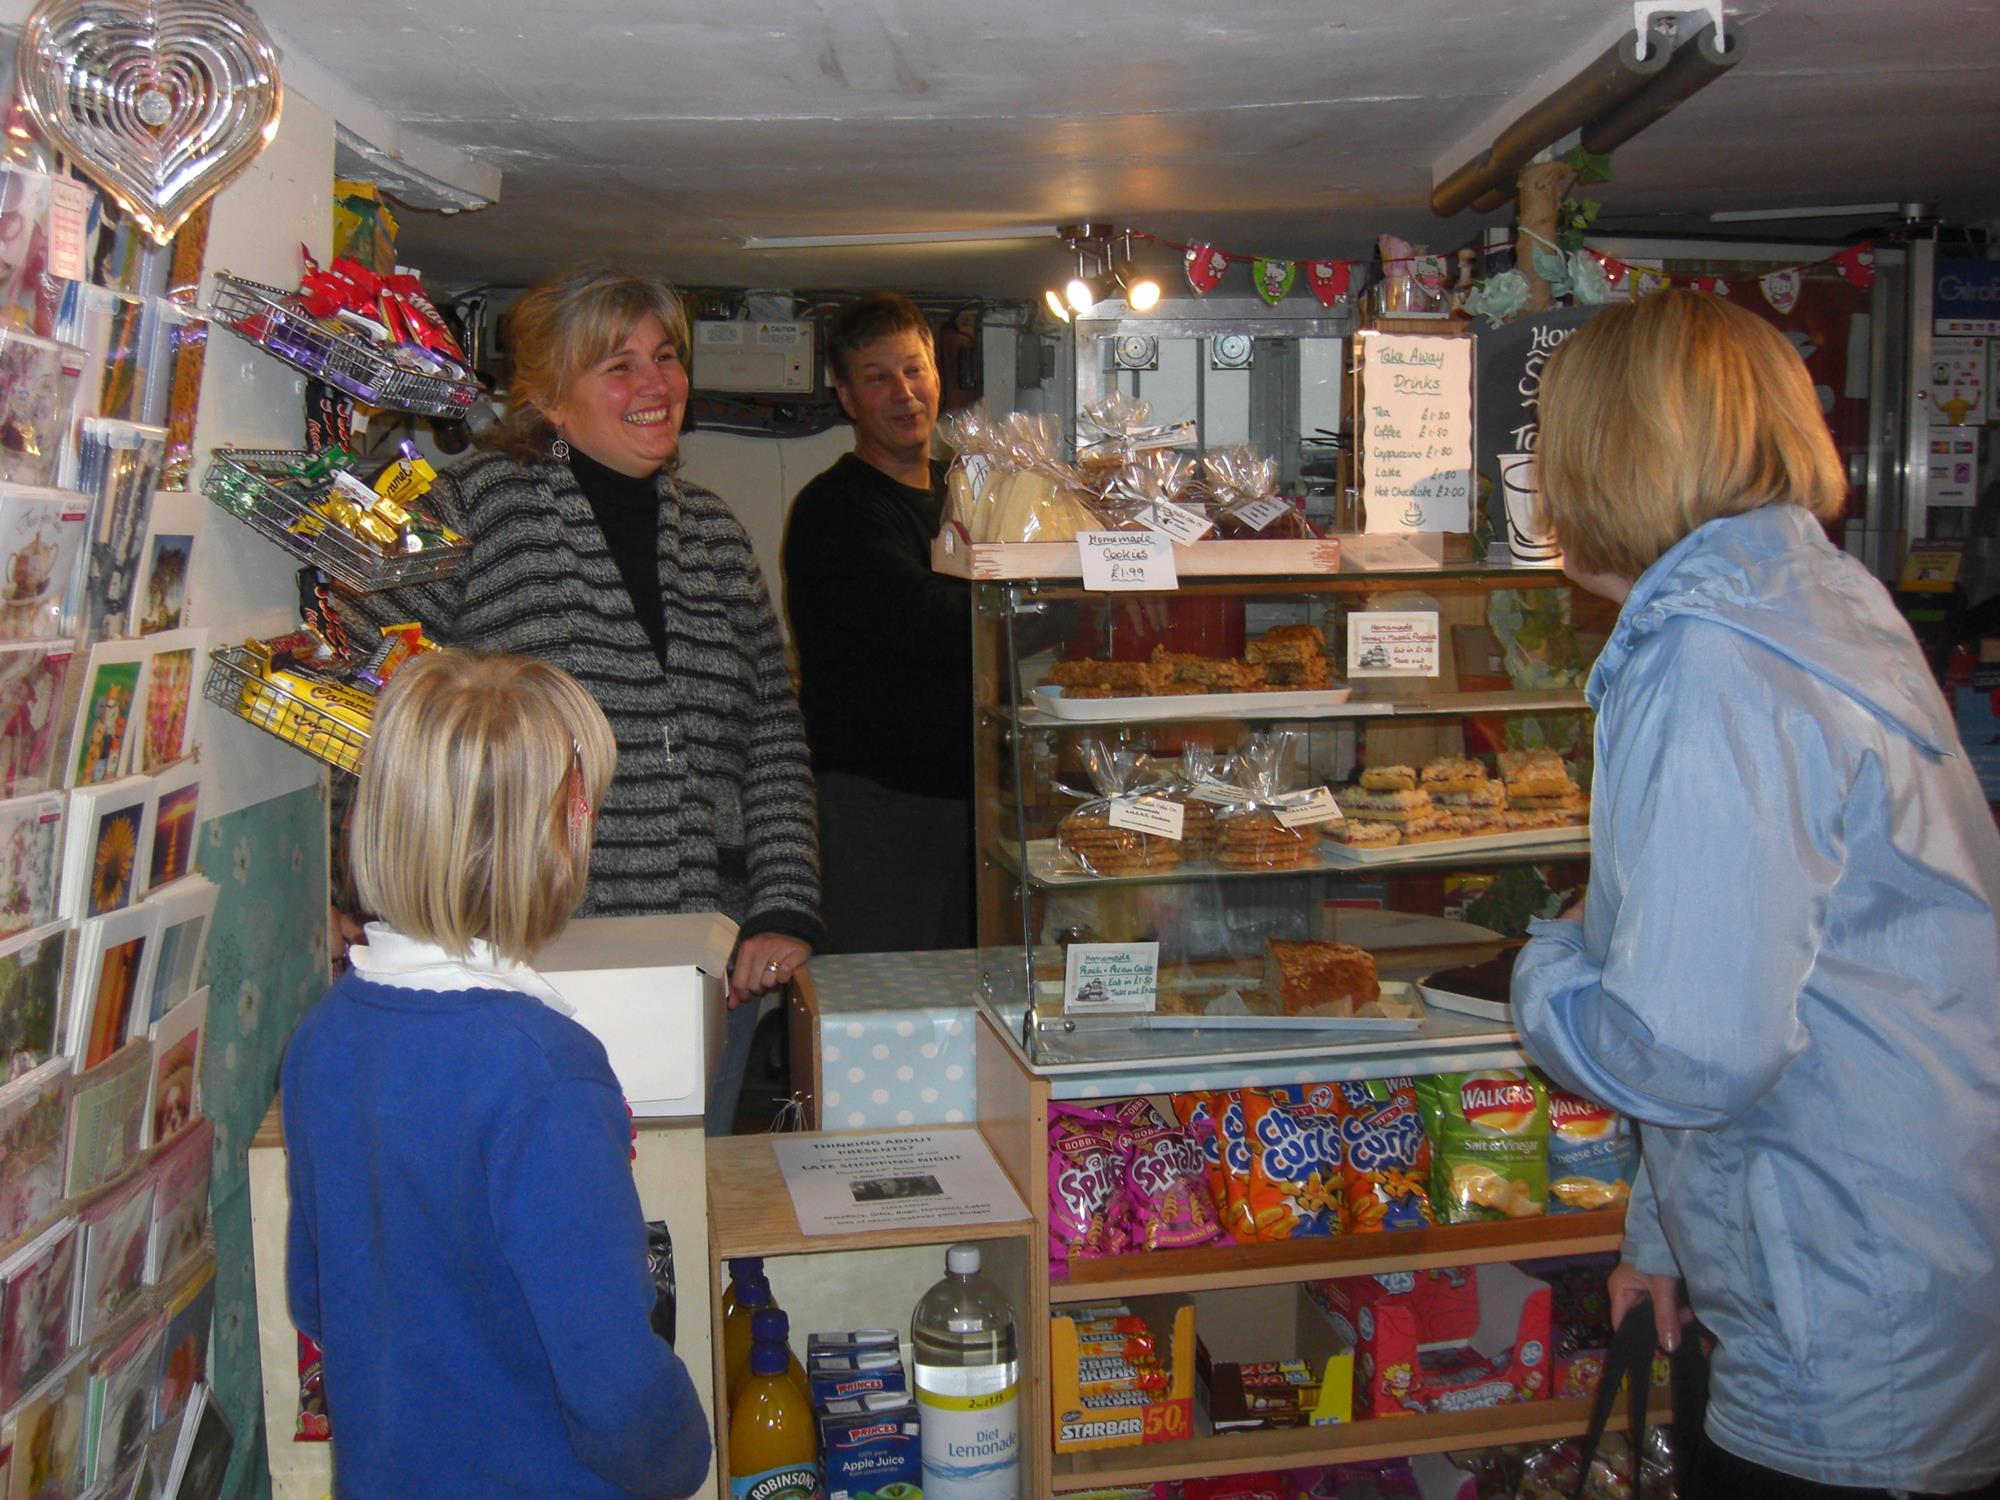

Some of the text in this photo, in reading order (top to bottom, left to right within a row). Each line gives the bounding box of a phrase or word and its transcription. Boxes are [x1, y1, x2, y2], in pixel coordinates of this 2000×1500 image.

[1377, 346, 1444, 369] Take Away
[1393, 374, 1440, 390] Drinks
[1372, 406, 1391, 418] Tea
[1373, 424, 1402, 440] Coffee
[1373, 446, 1422, 462] Cappuccino
[1375, 467, 1402, 477] Latte
[1374, 484, 1389, 497] Hot
[1391, 485, 1432, 497] Chocolate
[1088, 533, 1152, 544] Homemade
[1103, 548, 1148, 560] Cookies
[1111, 564, 1144, 579] £1.99
[1460, 1086, 1535, 1110] WALKERS
[813, 1136, 932, 1150] THINKING ABOUT
[1464, 1139, 1488, 1151] Salt
[1502, 1139, 1539, 1154] Vinegar
[839, 1158, 915, 1168] SHOPPING
[917, 1154, 962, 1163] NIGHT
[836, 1379, 883, 1395] PRINCES
[848, 1424, 897, 1442] PRINCES
[976, 1428, 999, 1443] Diet
[1061, 1417, 1143, 1441] STARBAR
[948, 1431, 1017, 1457] Lemonade
[842, 1454, 905, 1474] Apple Juice
[751, 1471, 817, 1500] ROBINSONS
